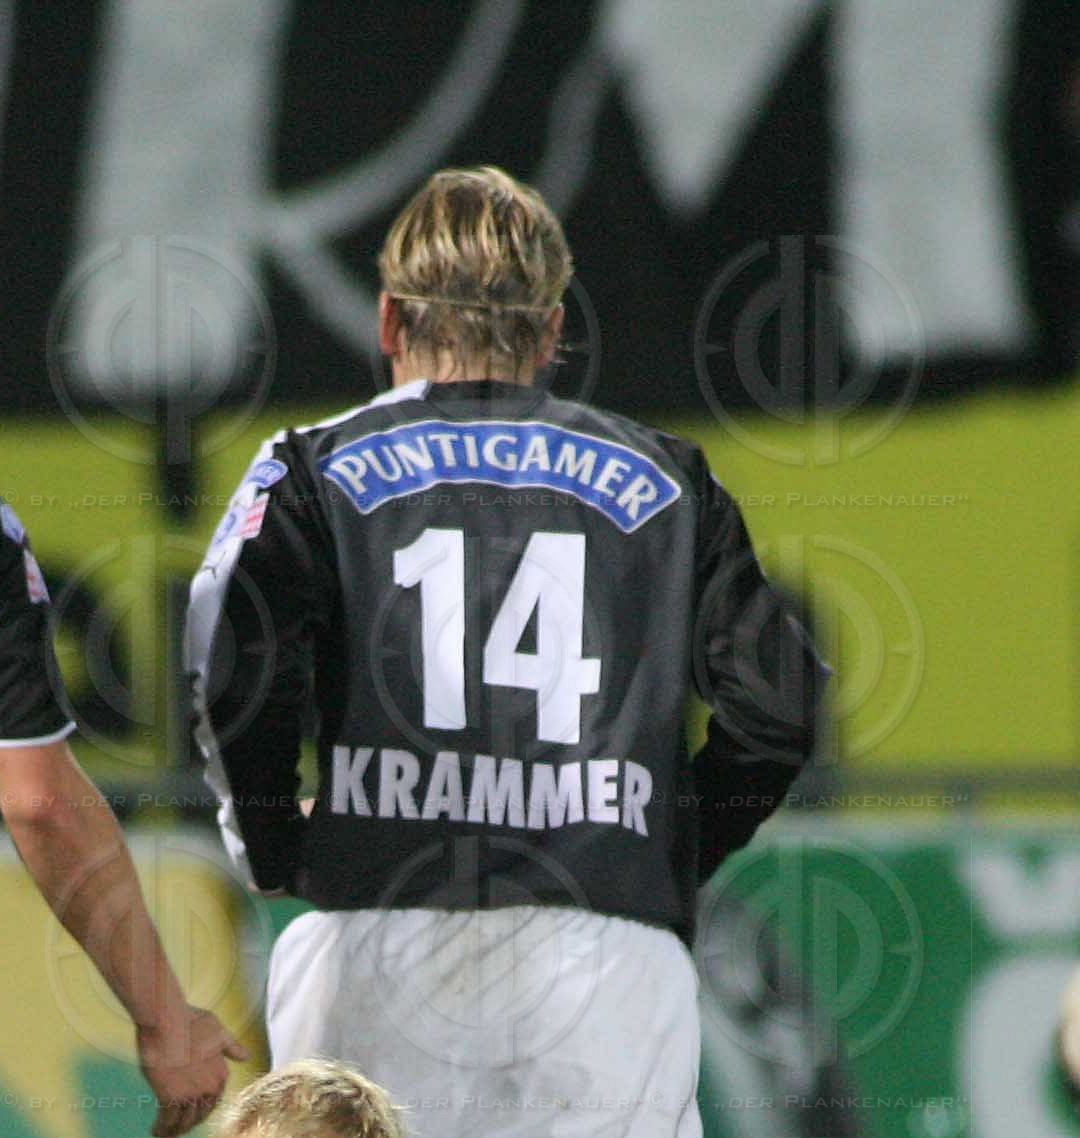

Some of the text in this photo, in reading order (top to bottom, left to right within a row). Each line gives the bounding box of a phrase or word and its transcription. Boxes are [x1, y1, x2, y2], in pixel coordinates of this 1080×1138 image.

[327, 432, 659, 521] PUNTIGAMER
[393, 528, 601, 745] 14
[331, 745, 653, 837] KRAMMER
